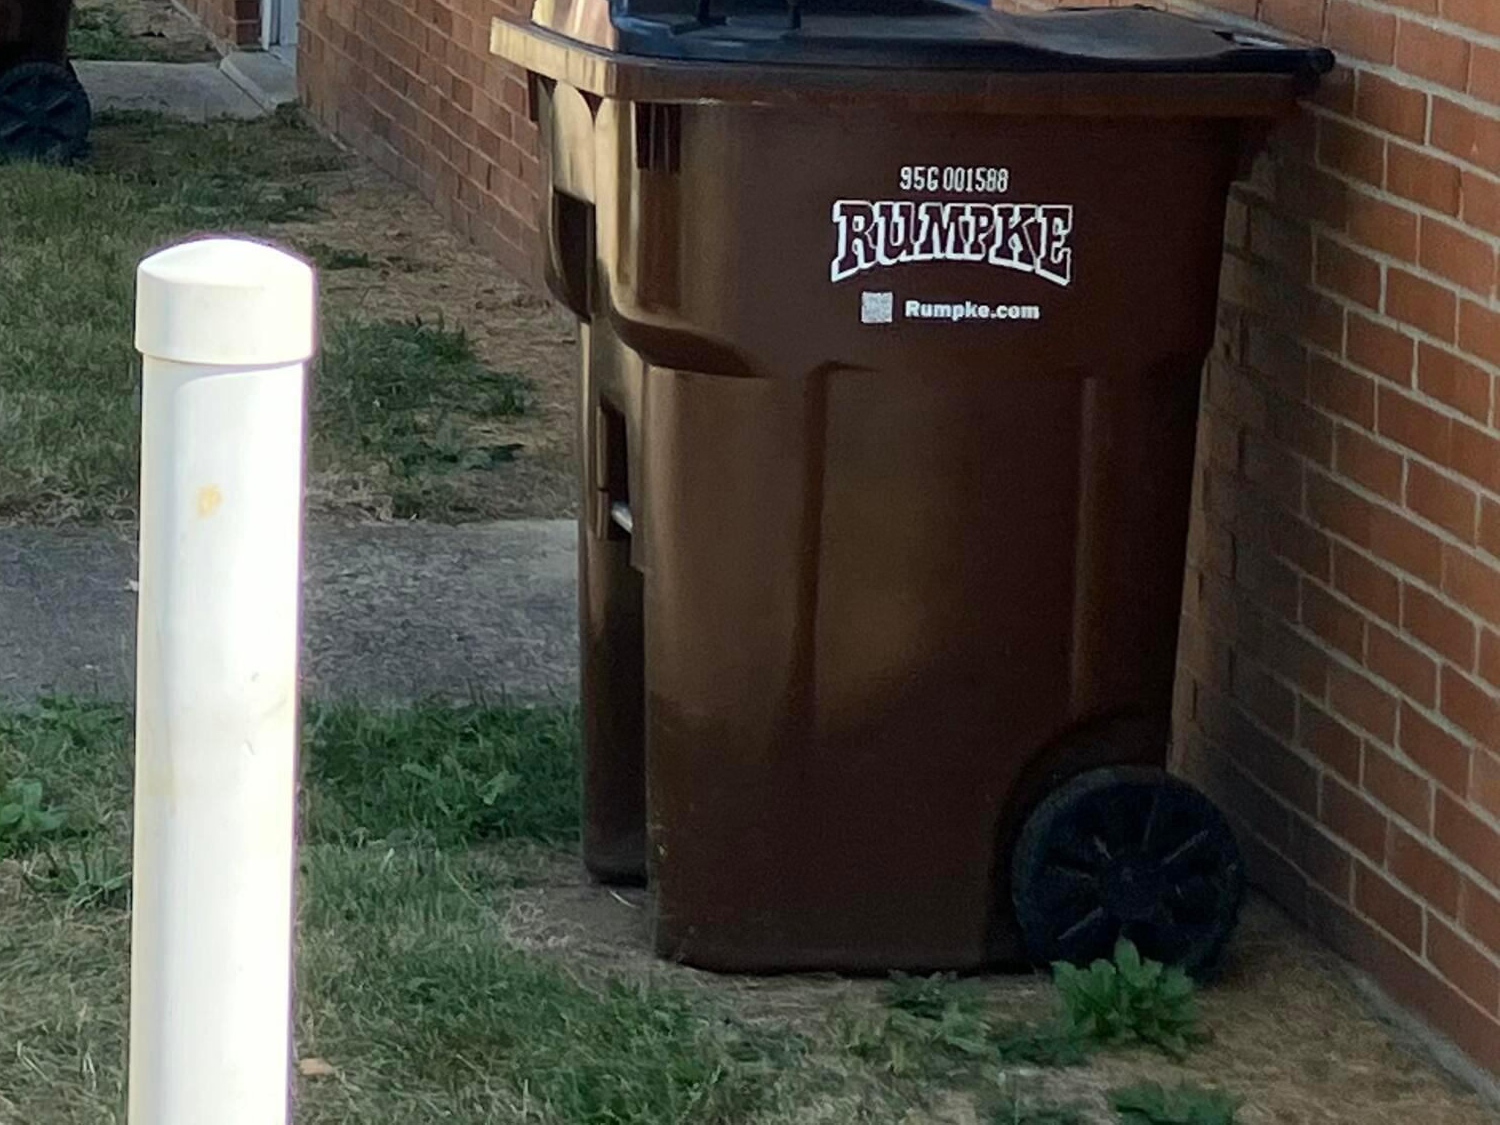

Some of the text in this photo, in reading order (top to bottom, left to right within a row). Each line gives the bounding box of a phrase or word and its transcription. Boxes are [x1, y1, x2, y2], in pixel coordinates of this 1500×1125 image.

[942, 167, 1009, 193] 001588
[831, 200, 1074, 286] RUMPKE
[904, 300, 1040, 322] Rumpke.com
